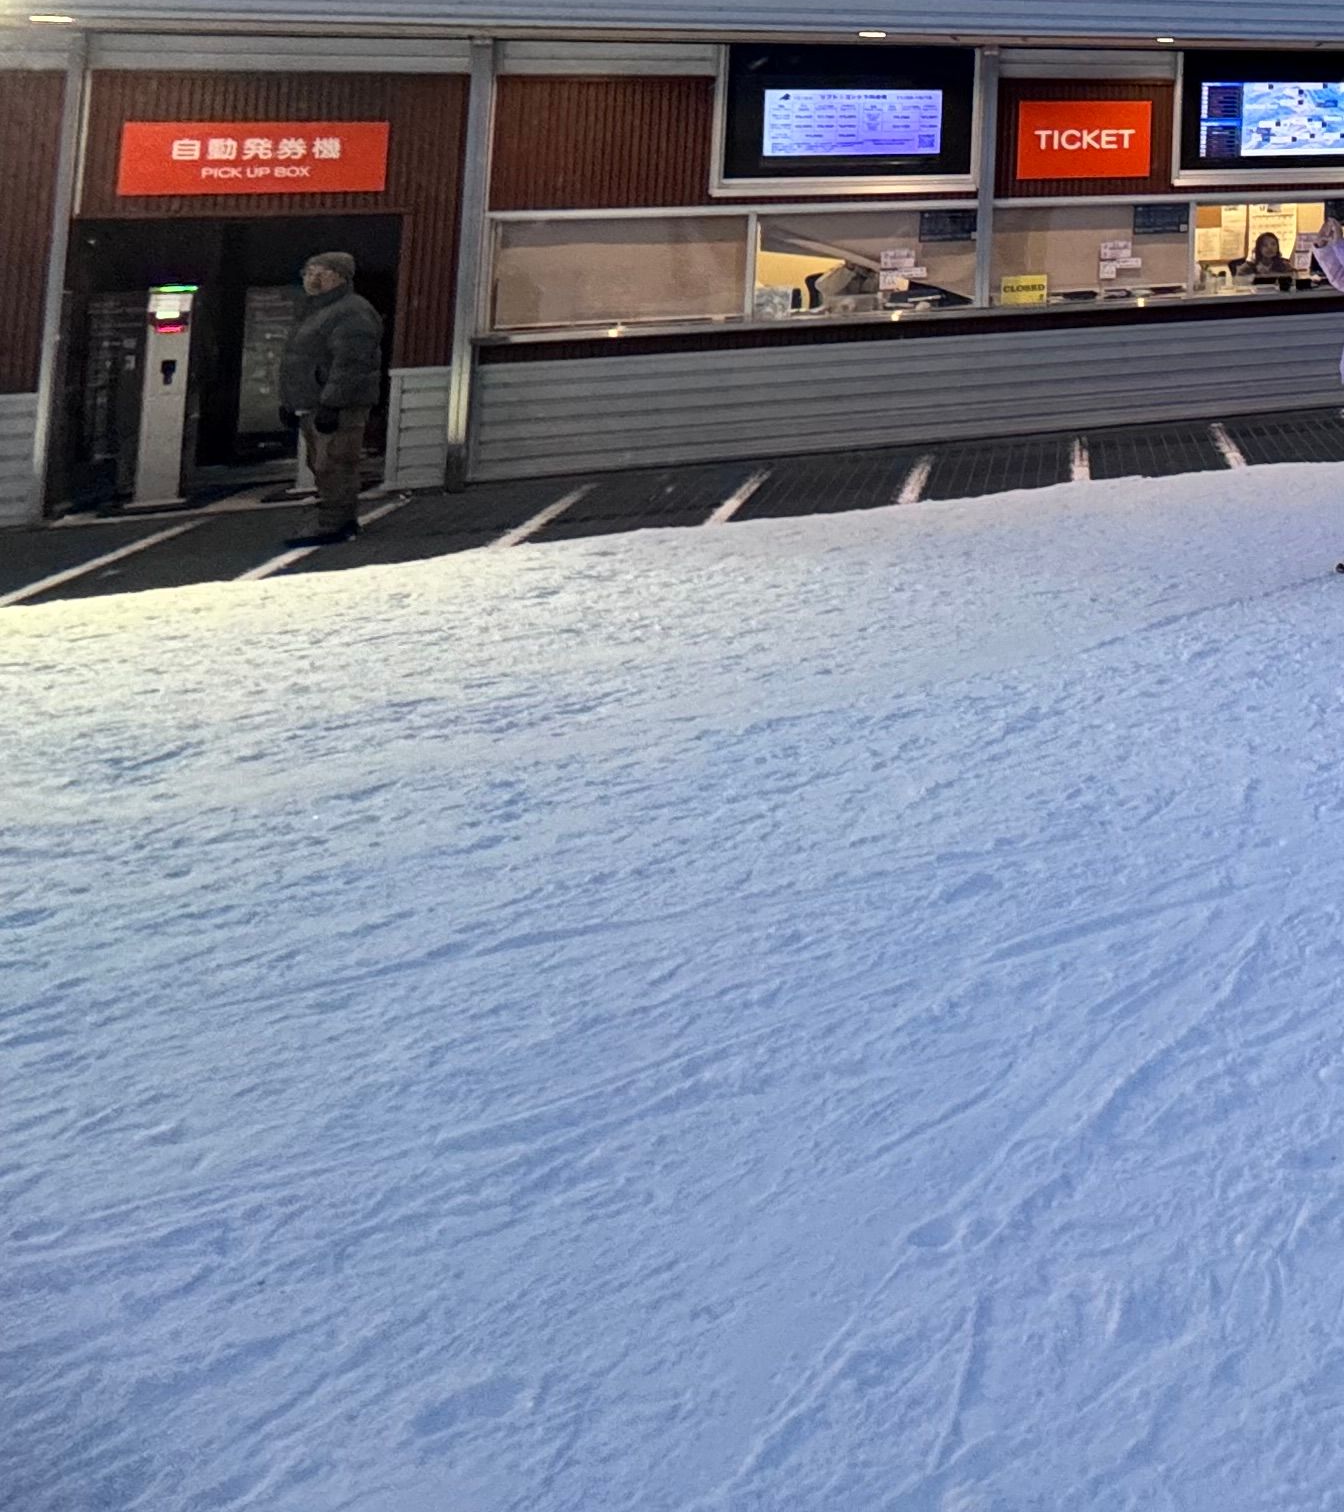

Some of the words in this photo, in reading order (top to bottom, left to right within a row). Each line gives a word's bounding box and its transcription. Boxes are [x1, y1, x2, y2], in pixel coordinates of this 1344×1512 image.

[171, 136, 342, 161] 自動発券機
[1033, 129, 1137, 151] TICKET
[200, 166, 242, 179] PICK
[246, 165, 271, 178] UP
[273, 165, 311, 178] BOX
[1003, 283, 1046, 294] CLOSED
